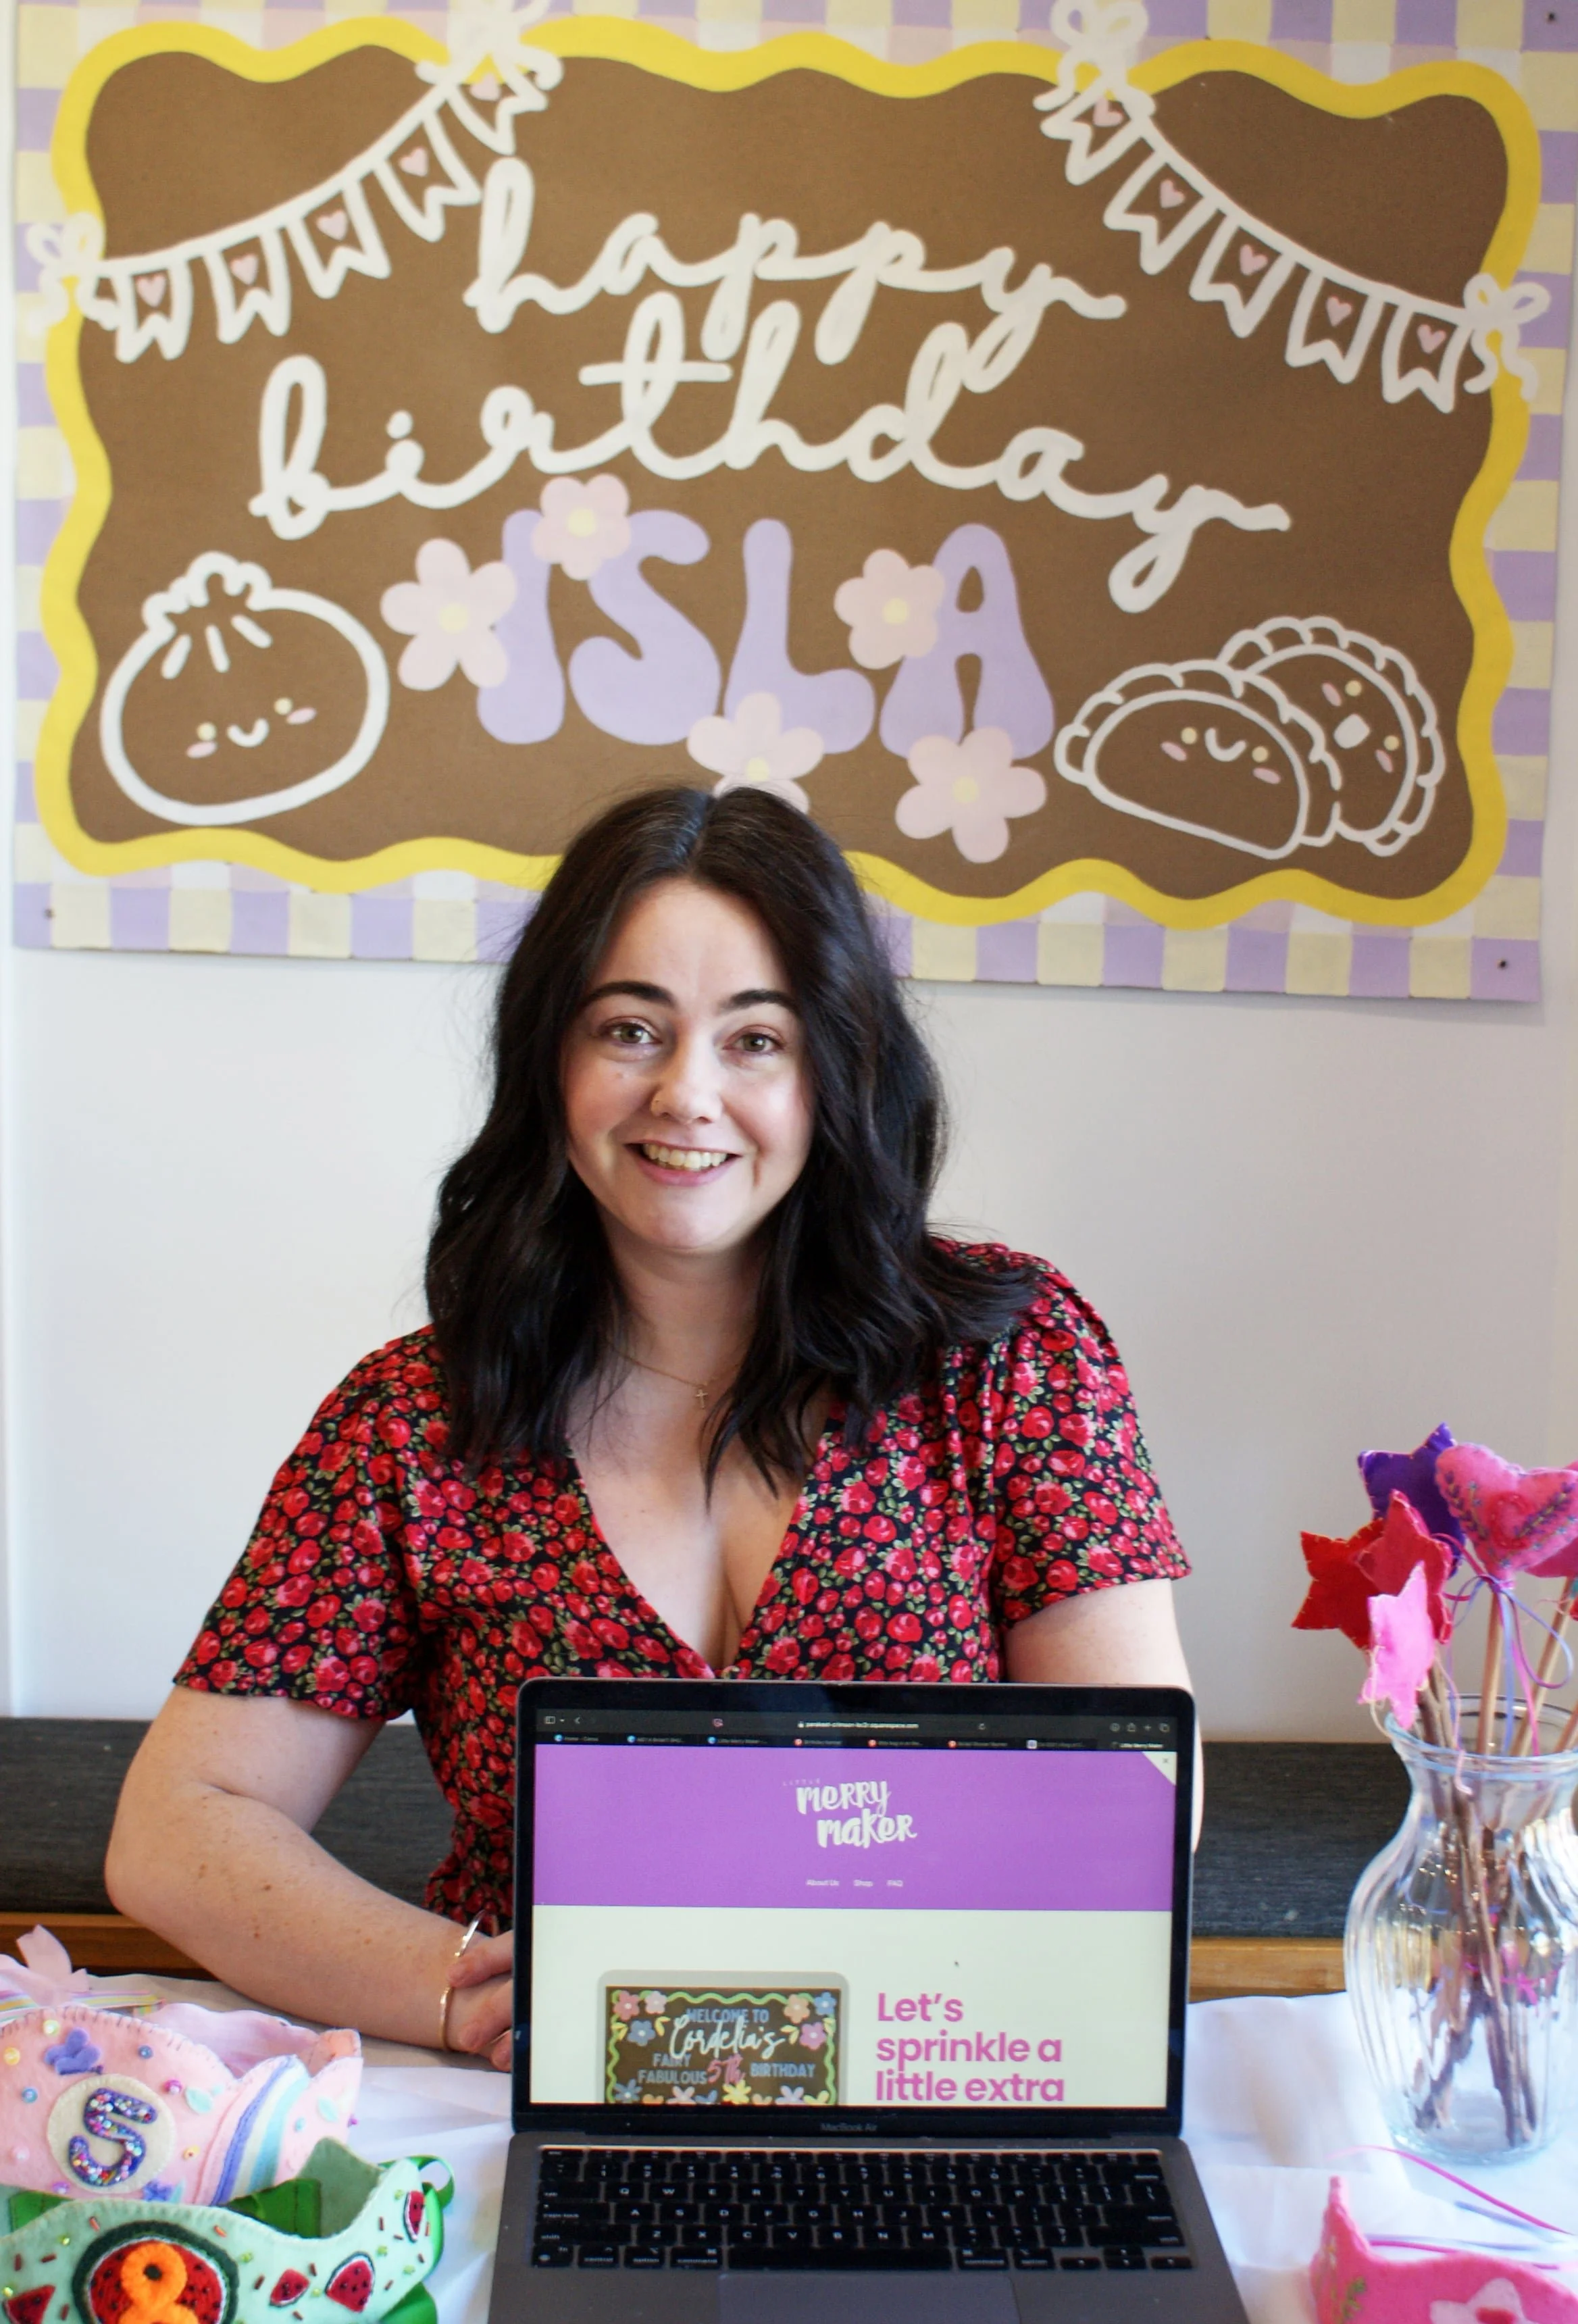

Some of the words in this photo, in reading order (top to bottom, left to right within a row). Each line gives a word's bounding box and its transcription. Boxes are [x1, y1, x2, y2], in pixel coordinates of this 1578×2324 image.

[463, 157, 1127, 393] happy
[249, 290, 1292, 613] birthday
[477, 508, 1054, 761] ISLA
[686, 2007, 748, 2024] WELCOME
[753, 2009, 769, 2023] TO
[877, 1992, 963, 2022] Let's
[669, 2015, 786, 2059] Cordelia's
[876, 2029, 1031, 2072] sprinkle
[1038, 2039, 1063, 2062] a
[638, 2069, 707, 2084] FABULOUS
[750, 2063, 816, 2078] BIRTHDAY
[876, 2069, 957, 2101] little
[965, 2073, 1065, 2102] extra
[68, 2088, 158, 2187] S
